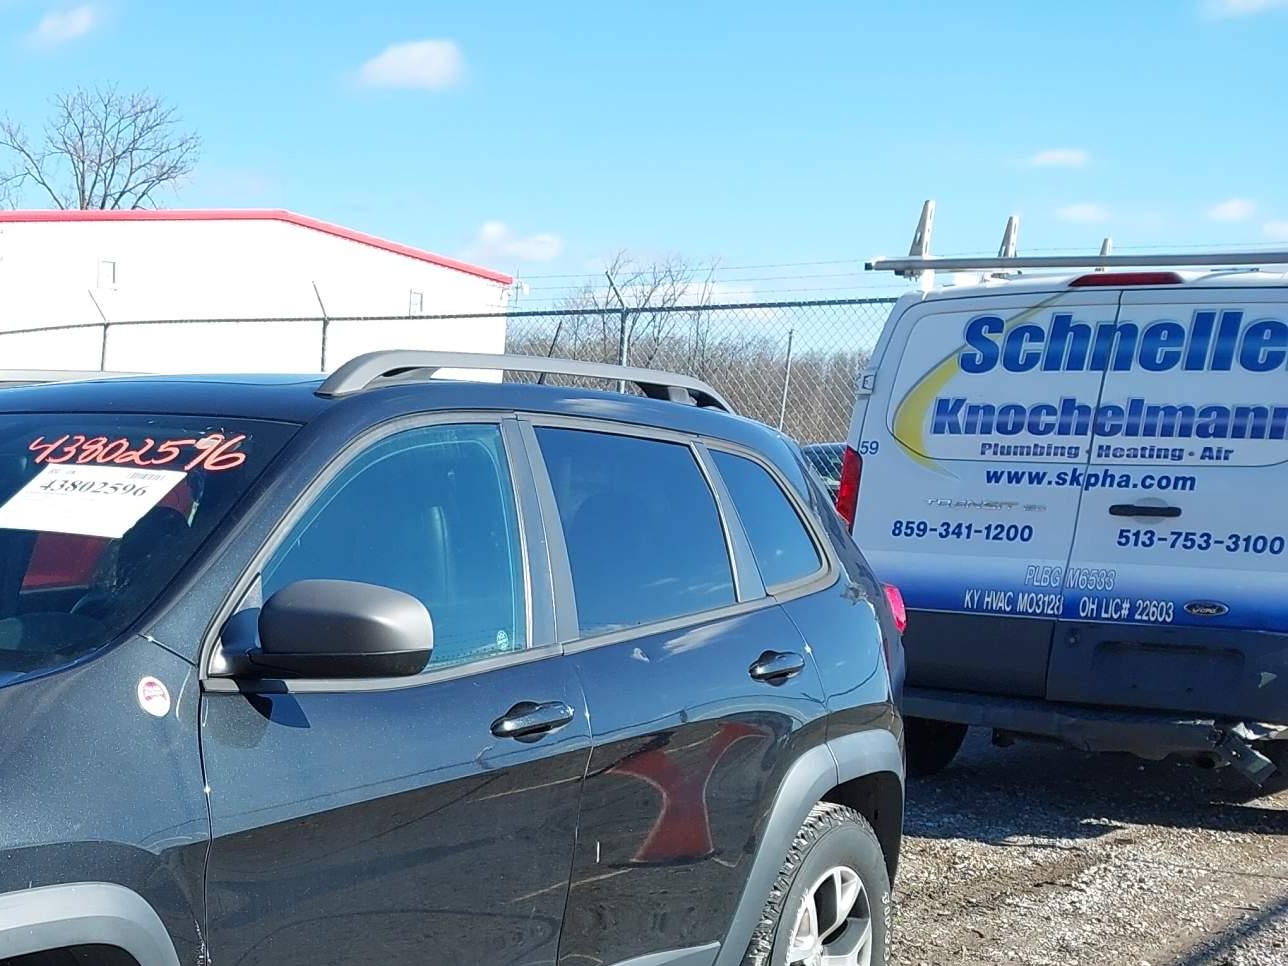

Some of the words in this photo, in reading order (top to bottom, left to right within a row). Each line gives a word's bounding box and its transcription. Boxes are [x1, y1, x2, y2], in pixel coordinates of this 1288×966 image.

[960, 311, 1288, 373] Schnelle
[29, 433, 246, 471] 43802596
[861, 441, 879, 455] 59
[980, 443, 1080, 459] Plumbing
[1097, 445, 1185, 461] Heating
[1200, 446, 1234, 461] Air
[40, 479, 148, 497] 43802596
[985, 467, 1196, 491] www.skpha.com
[891, 520, 1034, 542] 859-341-1200
[1116, 528, 1285, 554] 513-753-3100
[1025, 565, 1062, 587] PLBG
[1066, 568, 1116, 591] M6533
[964, 589, 981, 609] KY
[983, 590, 1013, 612] HVAC
[1079, 596, 1098, 617] OH
[1101, 598, 1130, 619] LIC#
[1134, 600, 1174, 622] 22603
